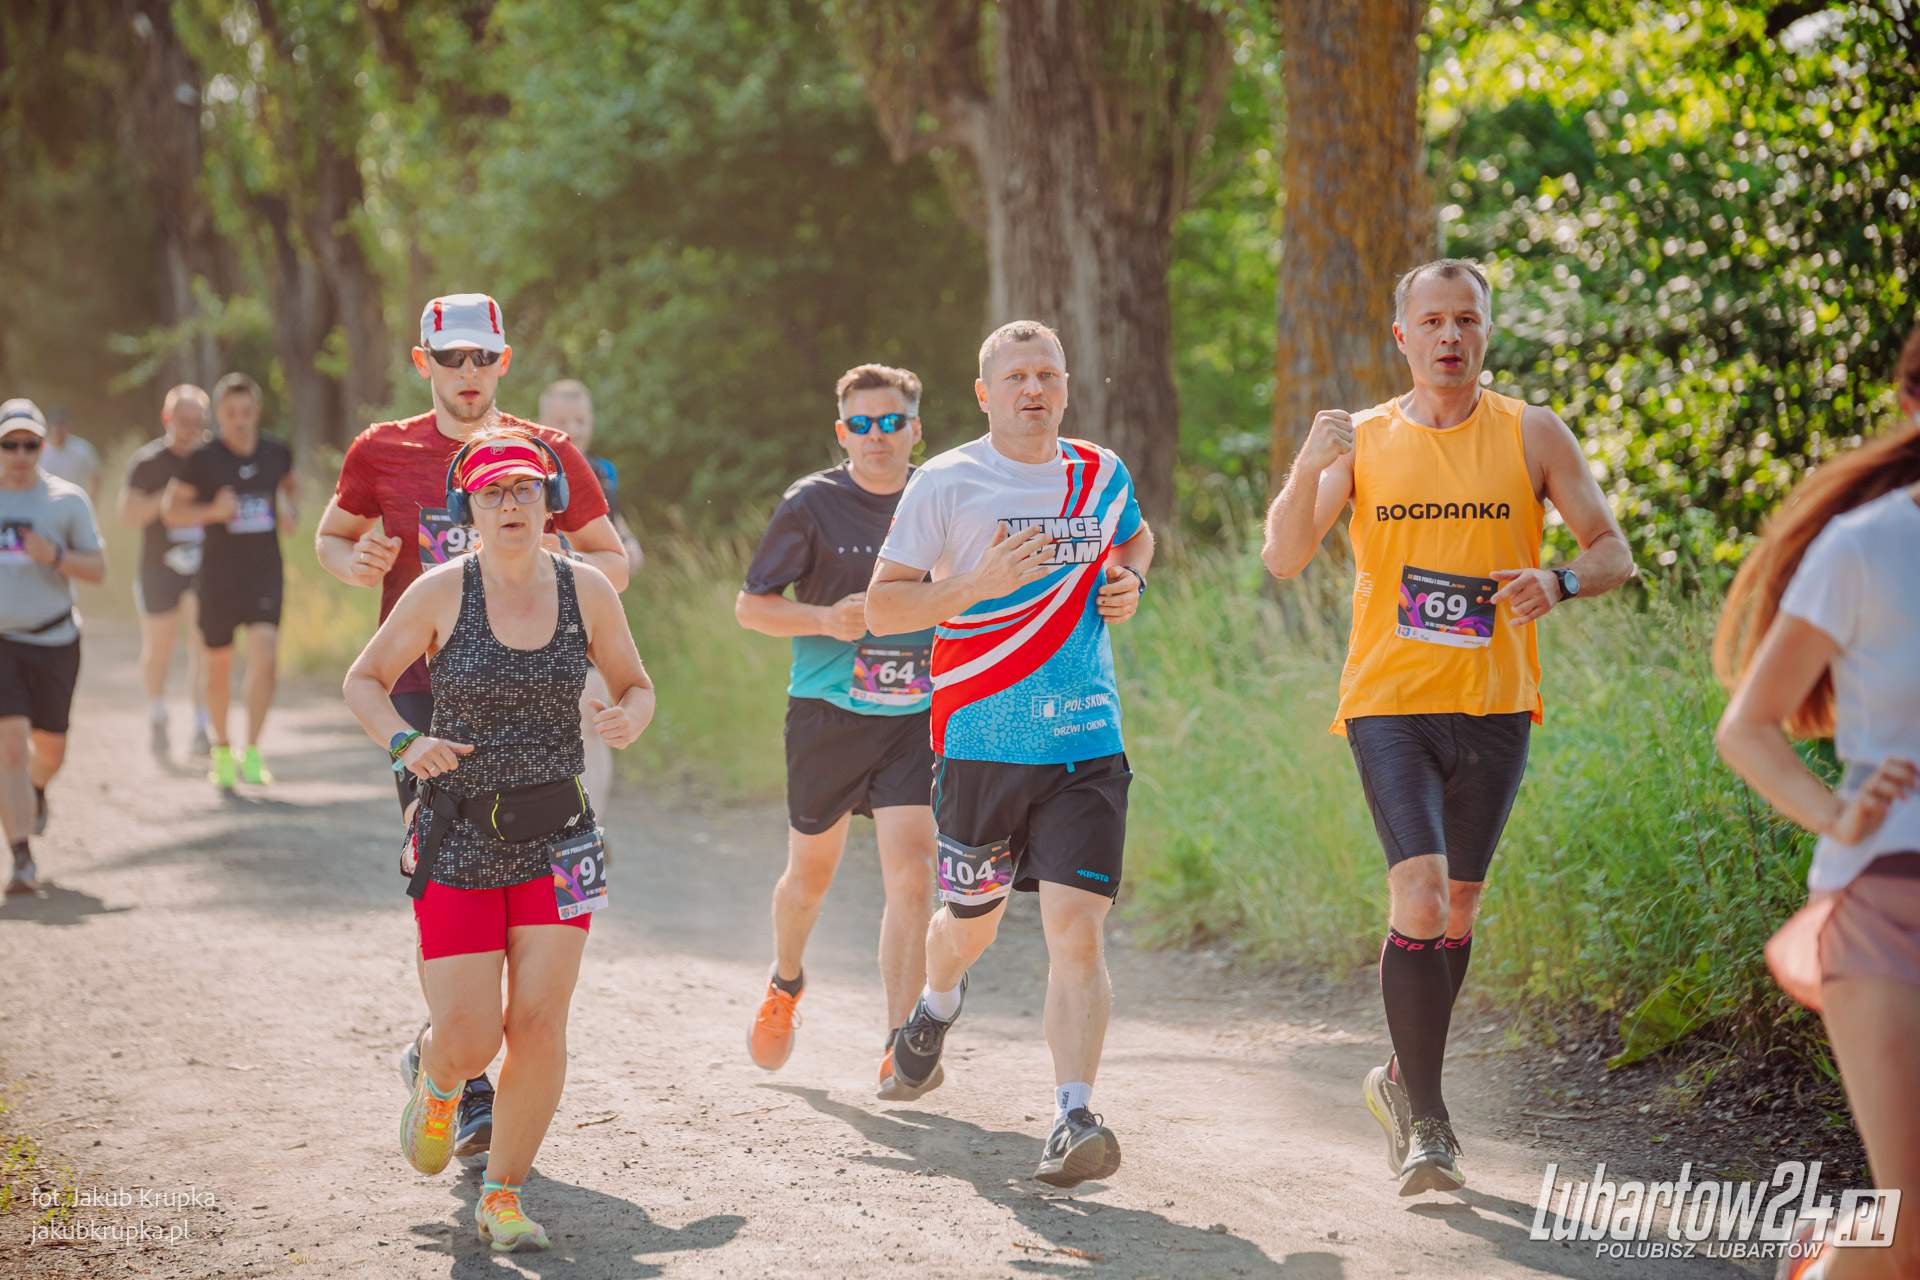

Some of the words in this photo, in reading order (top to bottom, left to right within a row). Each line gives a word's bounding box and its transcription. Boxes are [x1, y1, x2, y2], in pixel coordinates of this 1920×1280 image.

[1376, 502, 1510, 521] BOGDANKA
[1424, 591, 1468, 621] 69
[879, 660, 915, 685] 64
[942, 855, 996, 885] 104
